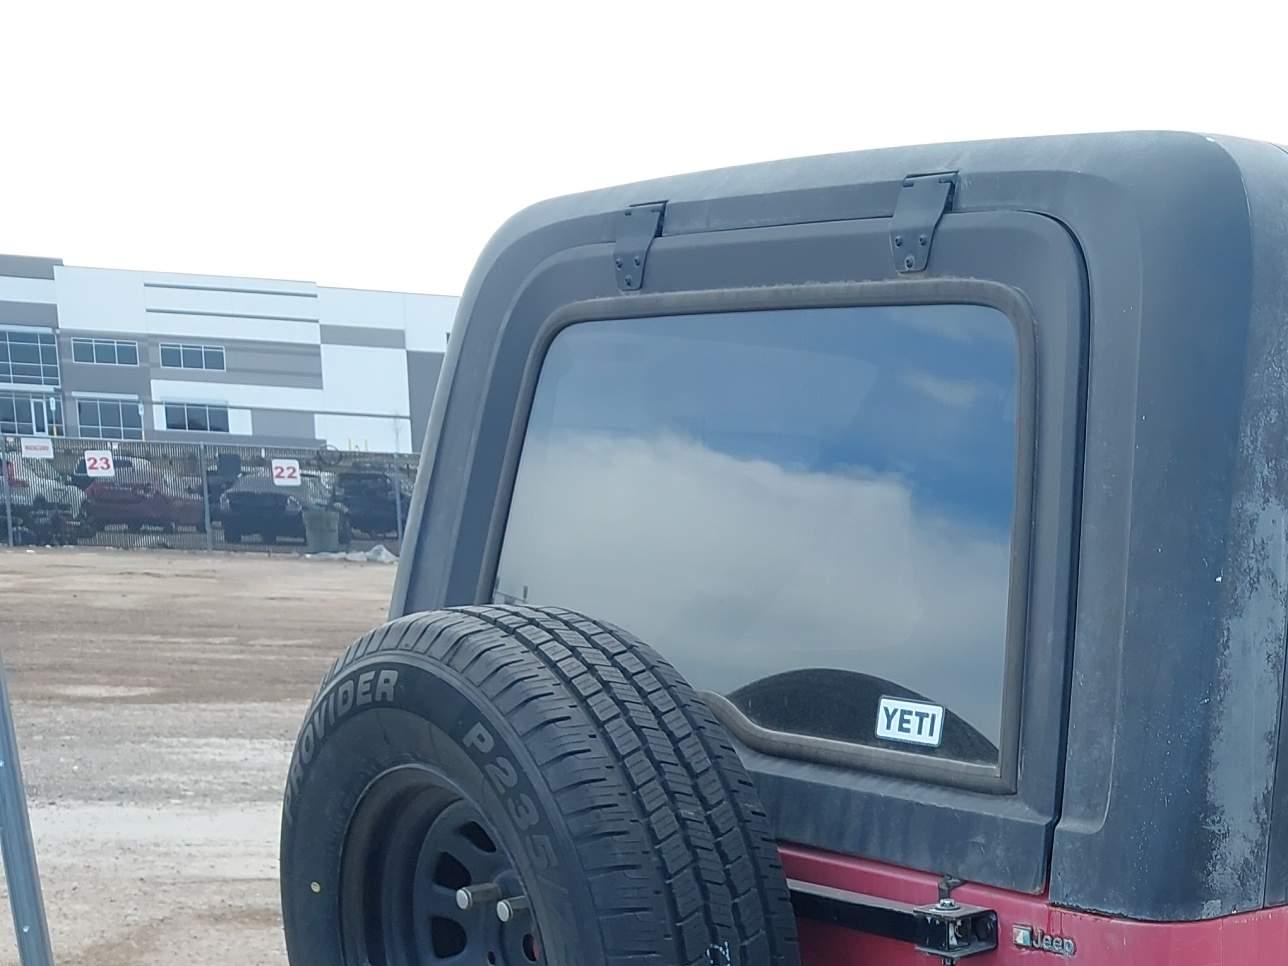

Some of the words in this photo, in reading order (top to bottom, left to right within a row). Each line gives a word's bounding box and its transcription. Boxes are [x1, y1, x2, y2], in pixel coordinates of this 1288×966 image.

[87, 457, 111, 471] 23
[274, 465, 298, 480] 22
[883, 706, 936, 738] YETI
[1032, 929, 1076, 957] Jeep
